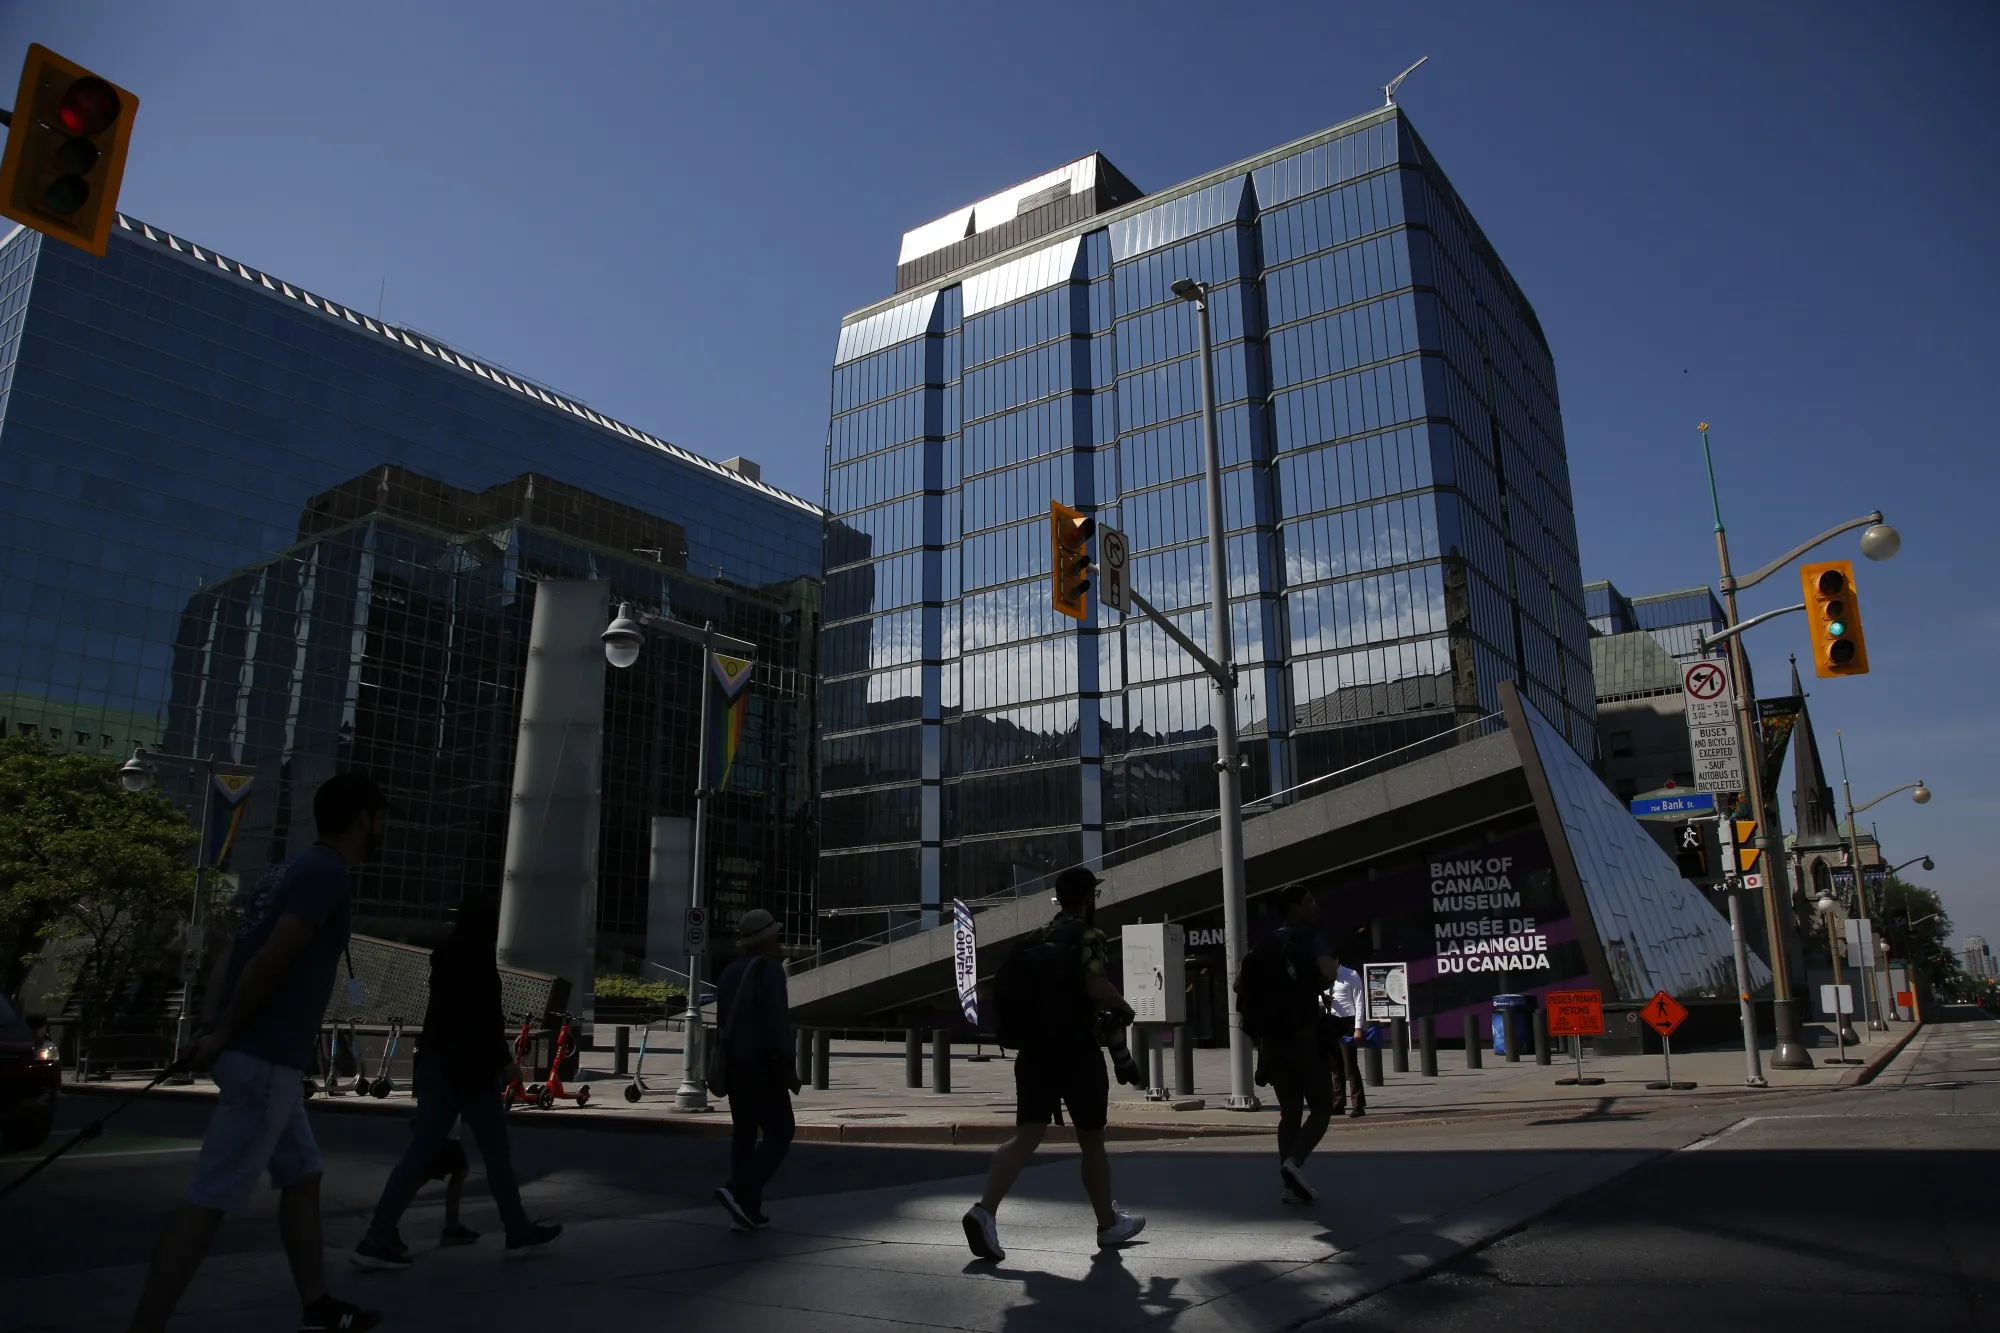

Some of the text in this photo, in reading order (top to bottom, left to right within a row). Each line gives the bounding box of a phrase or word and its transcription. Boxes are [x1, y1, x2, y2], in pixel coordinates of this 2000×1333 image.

[1691, 703, 1695, 711] 7
[1692, 712, 1697, 720] 3
[1700, 728, 1727, 738] BUSES
[1695, 737, 1736, 748] AND BICYCLES
[1699, 748, 1732, 758] EXCEPTED
[1709, 760, 1725, 770] SAUF
[1699, 769, 1738, 780] AUTOBUS ET
[1698, 780, 1741, 790] BICYCLETTES
[1662, 799, 1684, 811] Bank
[1430, 856, 1513, 878] BANK OF
[1431, 874, 1512, 895] CANADA
[1432, 892, 1521, 913] MUSEUM
[1434, 917, 1536, 939] MUSÉE DE
[1188, 928, 1226, 946] BAN
[1436, 935, 1548, 956] LA BANQUE
[956, 930, 965, 990] OUVERT
[965, 934, 973, 975] OPEN
[1437, 954, 1550, 974] DU CANADA
[1548, 994, 1598, 1004] PEDESTRIANS
[338, 1313, 354, 1329] N
